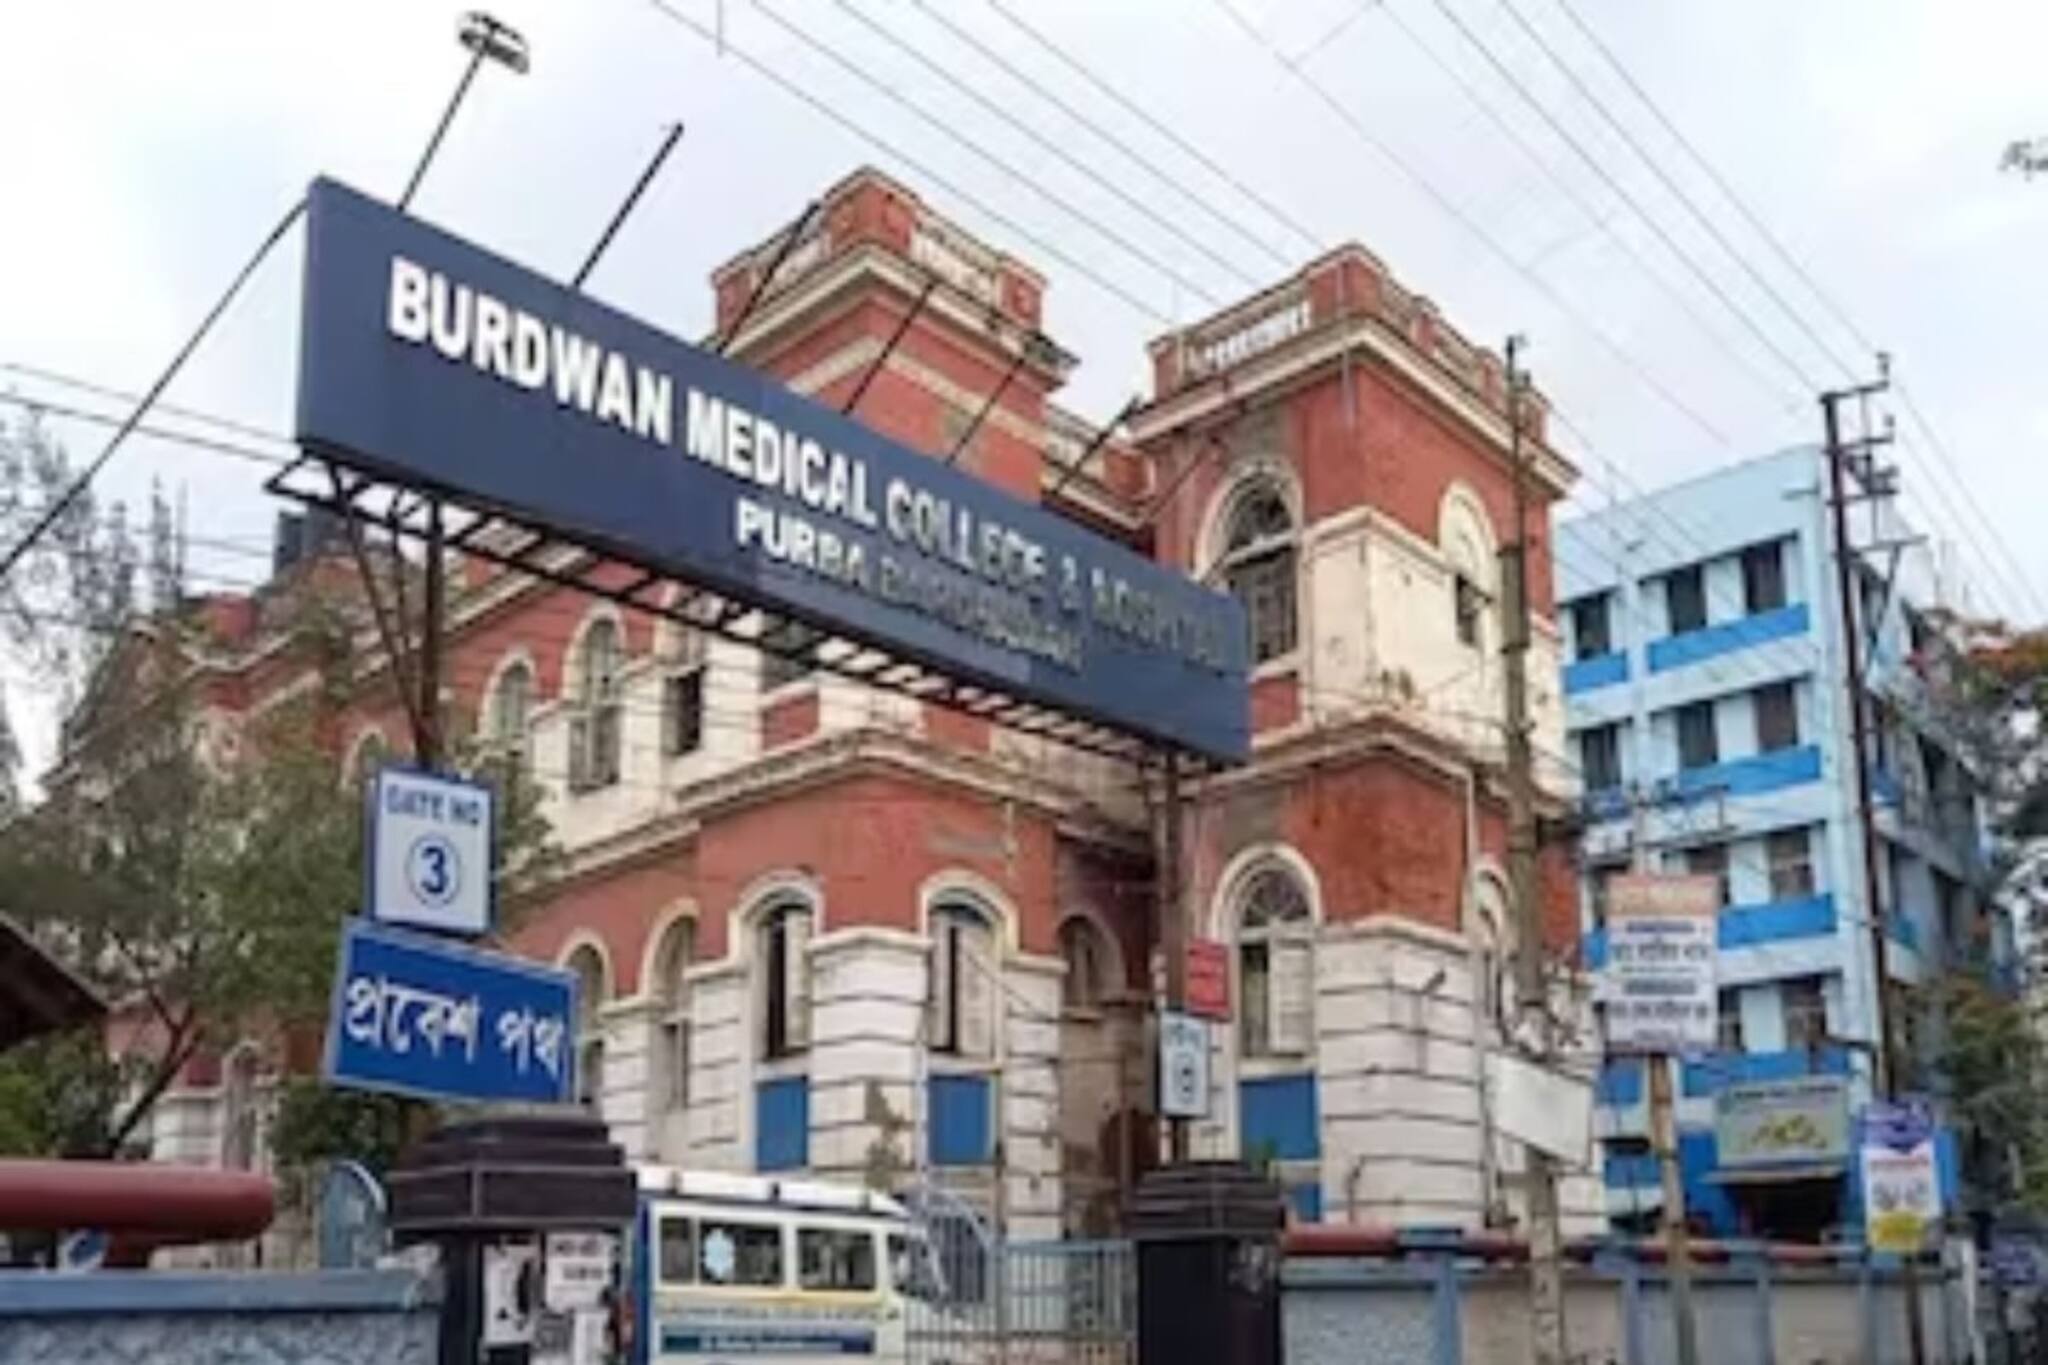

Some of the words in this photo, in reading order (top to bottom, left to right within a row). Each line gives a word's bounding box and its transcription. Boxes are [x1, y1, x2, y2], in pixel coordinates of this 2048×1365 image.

[388, 255, 672, 445] BURDWAN
[686, 387, 877, 526] MEDICAL
[736, 498, 872, 588] PURBA
[421, 846, 450, 895] 3
[346, 973, 480, 1064] প্রবেশ
[498, 1003, 566, 1080] পথ
